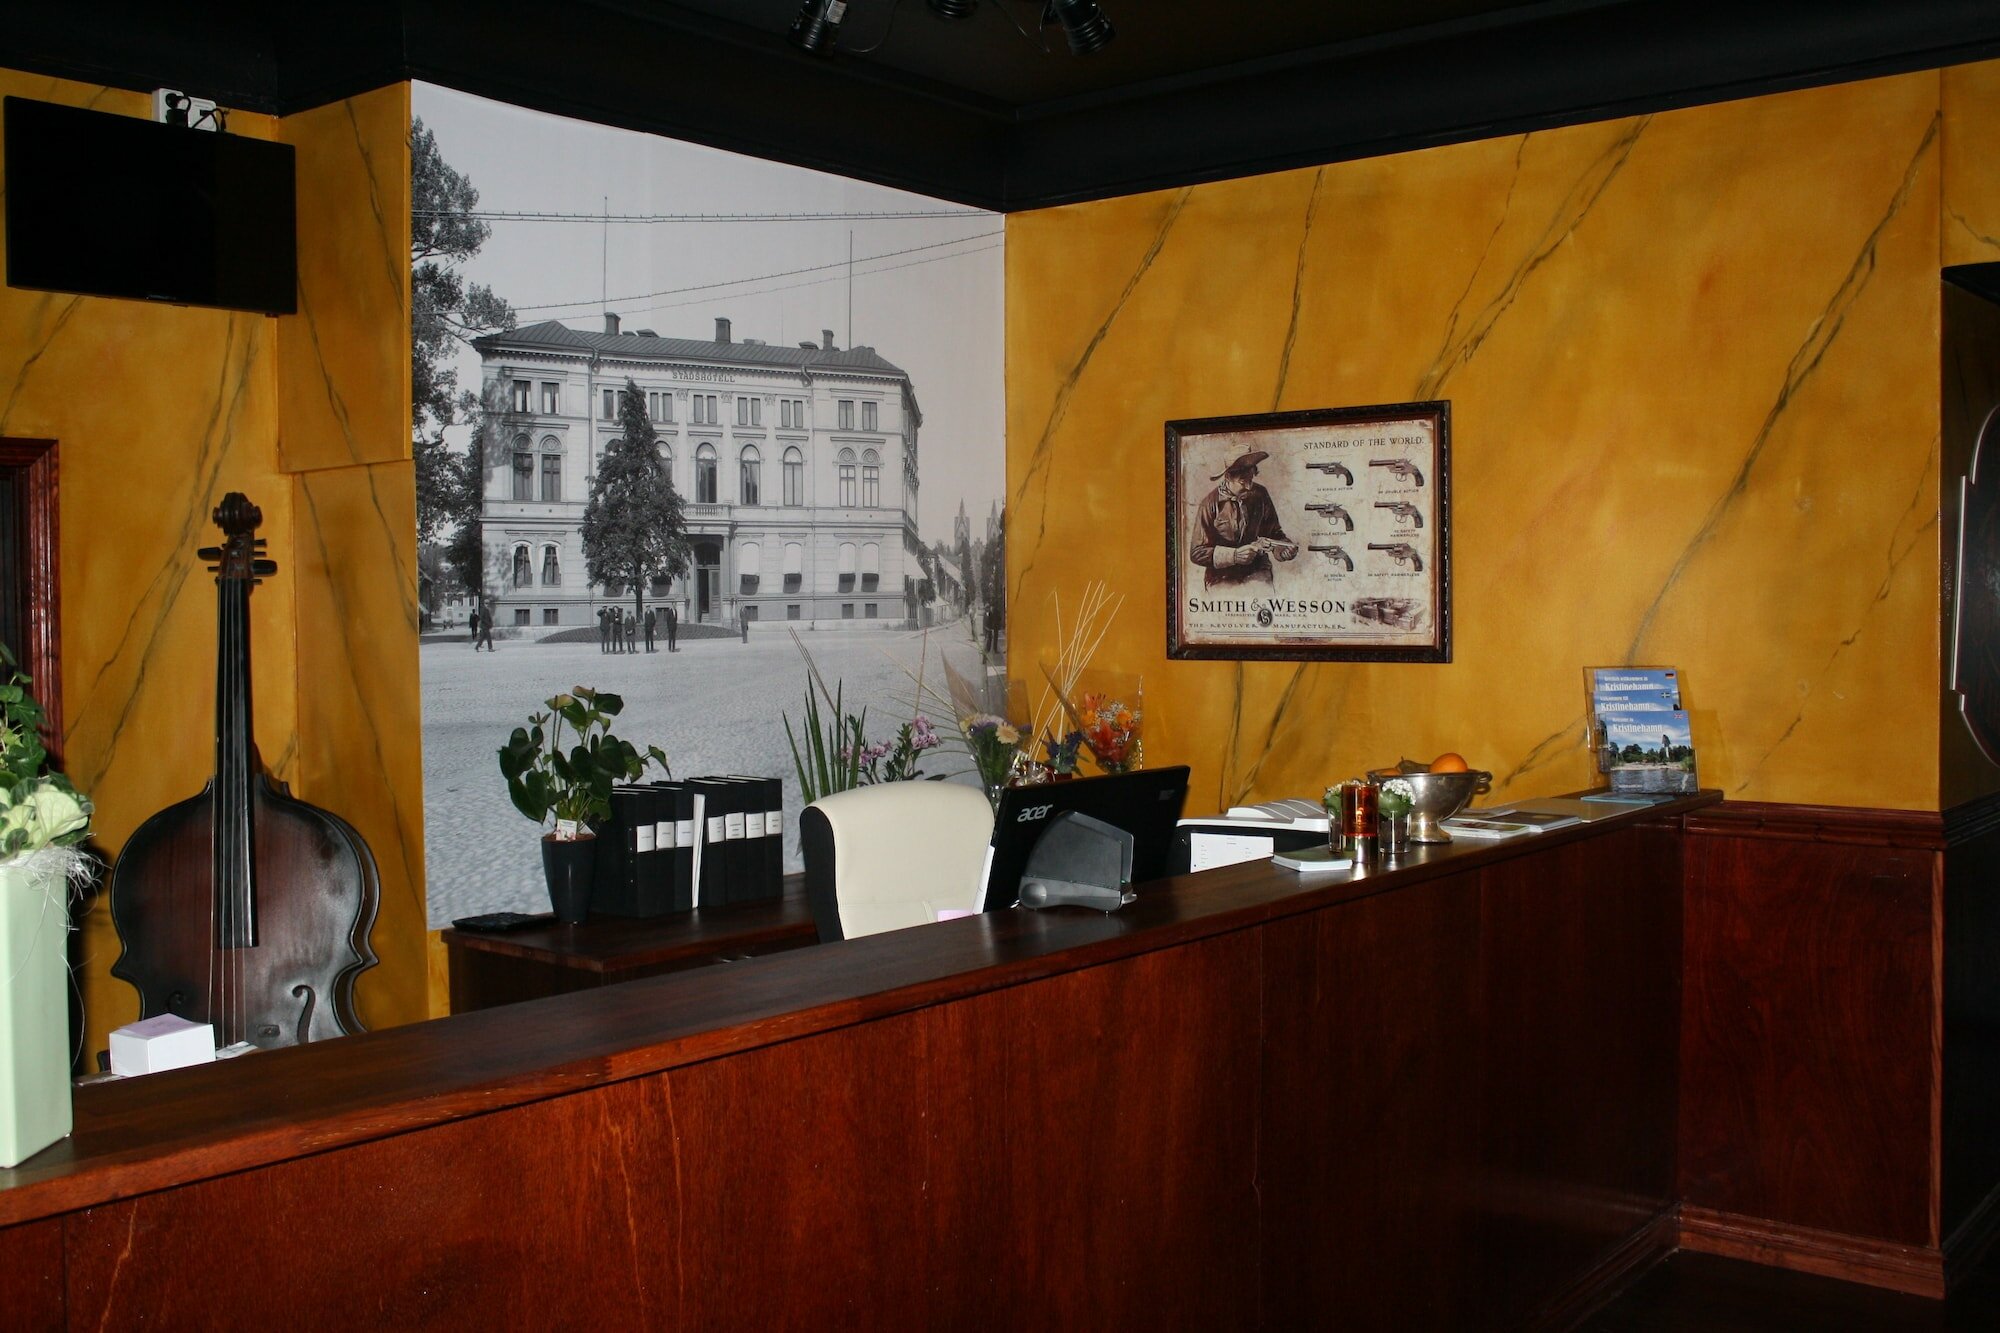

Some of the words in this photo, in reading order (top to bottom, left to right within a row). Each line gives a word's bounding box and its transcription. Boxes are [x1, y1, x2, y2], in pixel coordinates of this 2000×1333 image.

[672, 371, 736, 382] STADSHOTELL
[1303, 440, 1349, 450] STANDARD
[1352, 439, 1365, 447] OF
[1368, 438, 1386, 446] THE
[1188, 598, 1246, 613] SMITH
[1250, 598, 1267, 612] &
[1267, 599, 1346, 613] WESSON
[1604, 682, 1654, 691] Kristinehamn
[1600, 702, 1650, 711] Kristinehamn
[1612, 723, 1663, 733] Kristinehamn
[1017, 803, 1053, 823] acer
